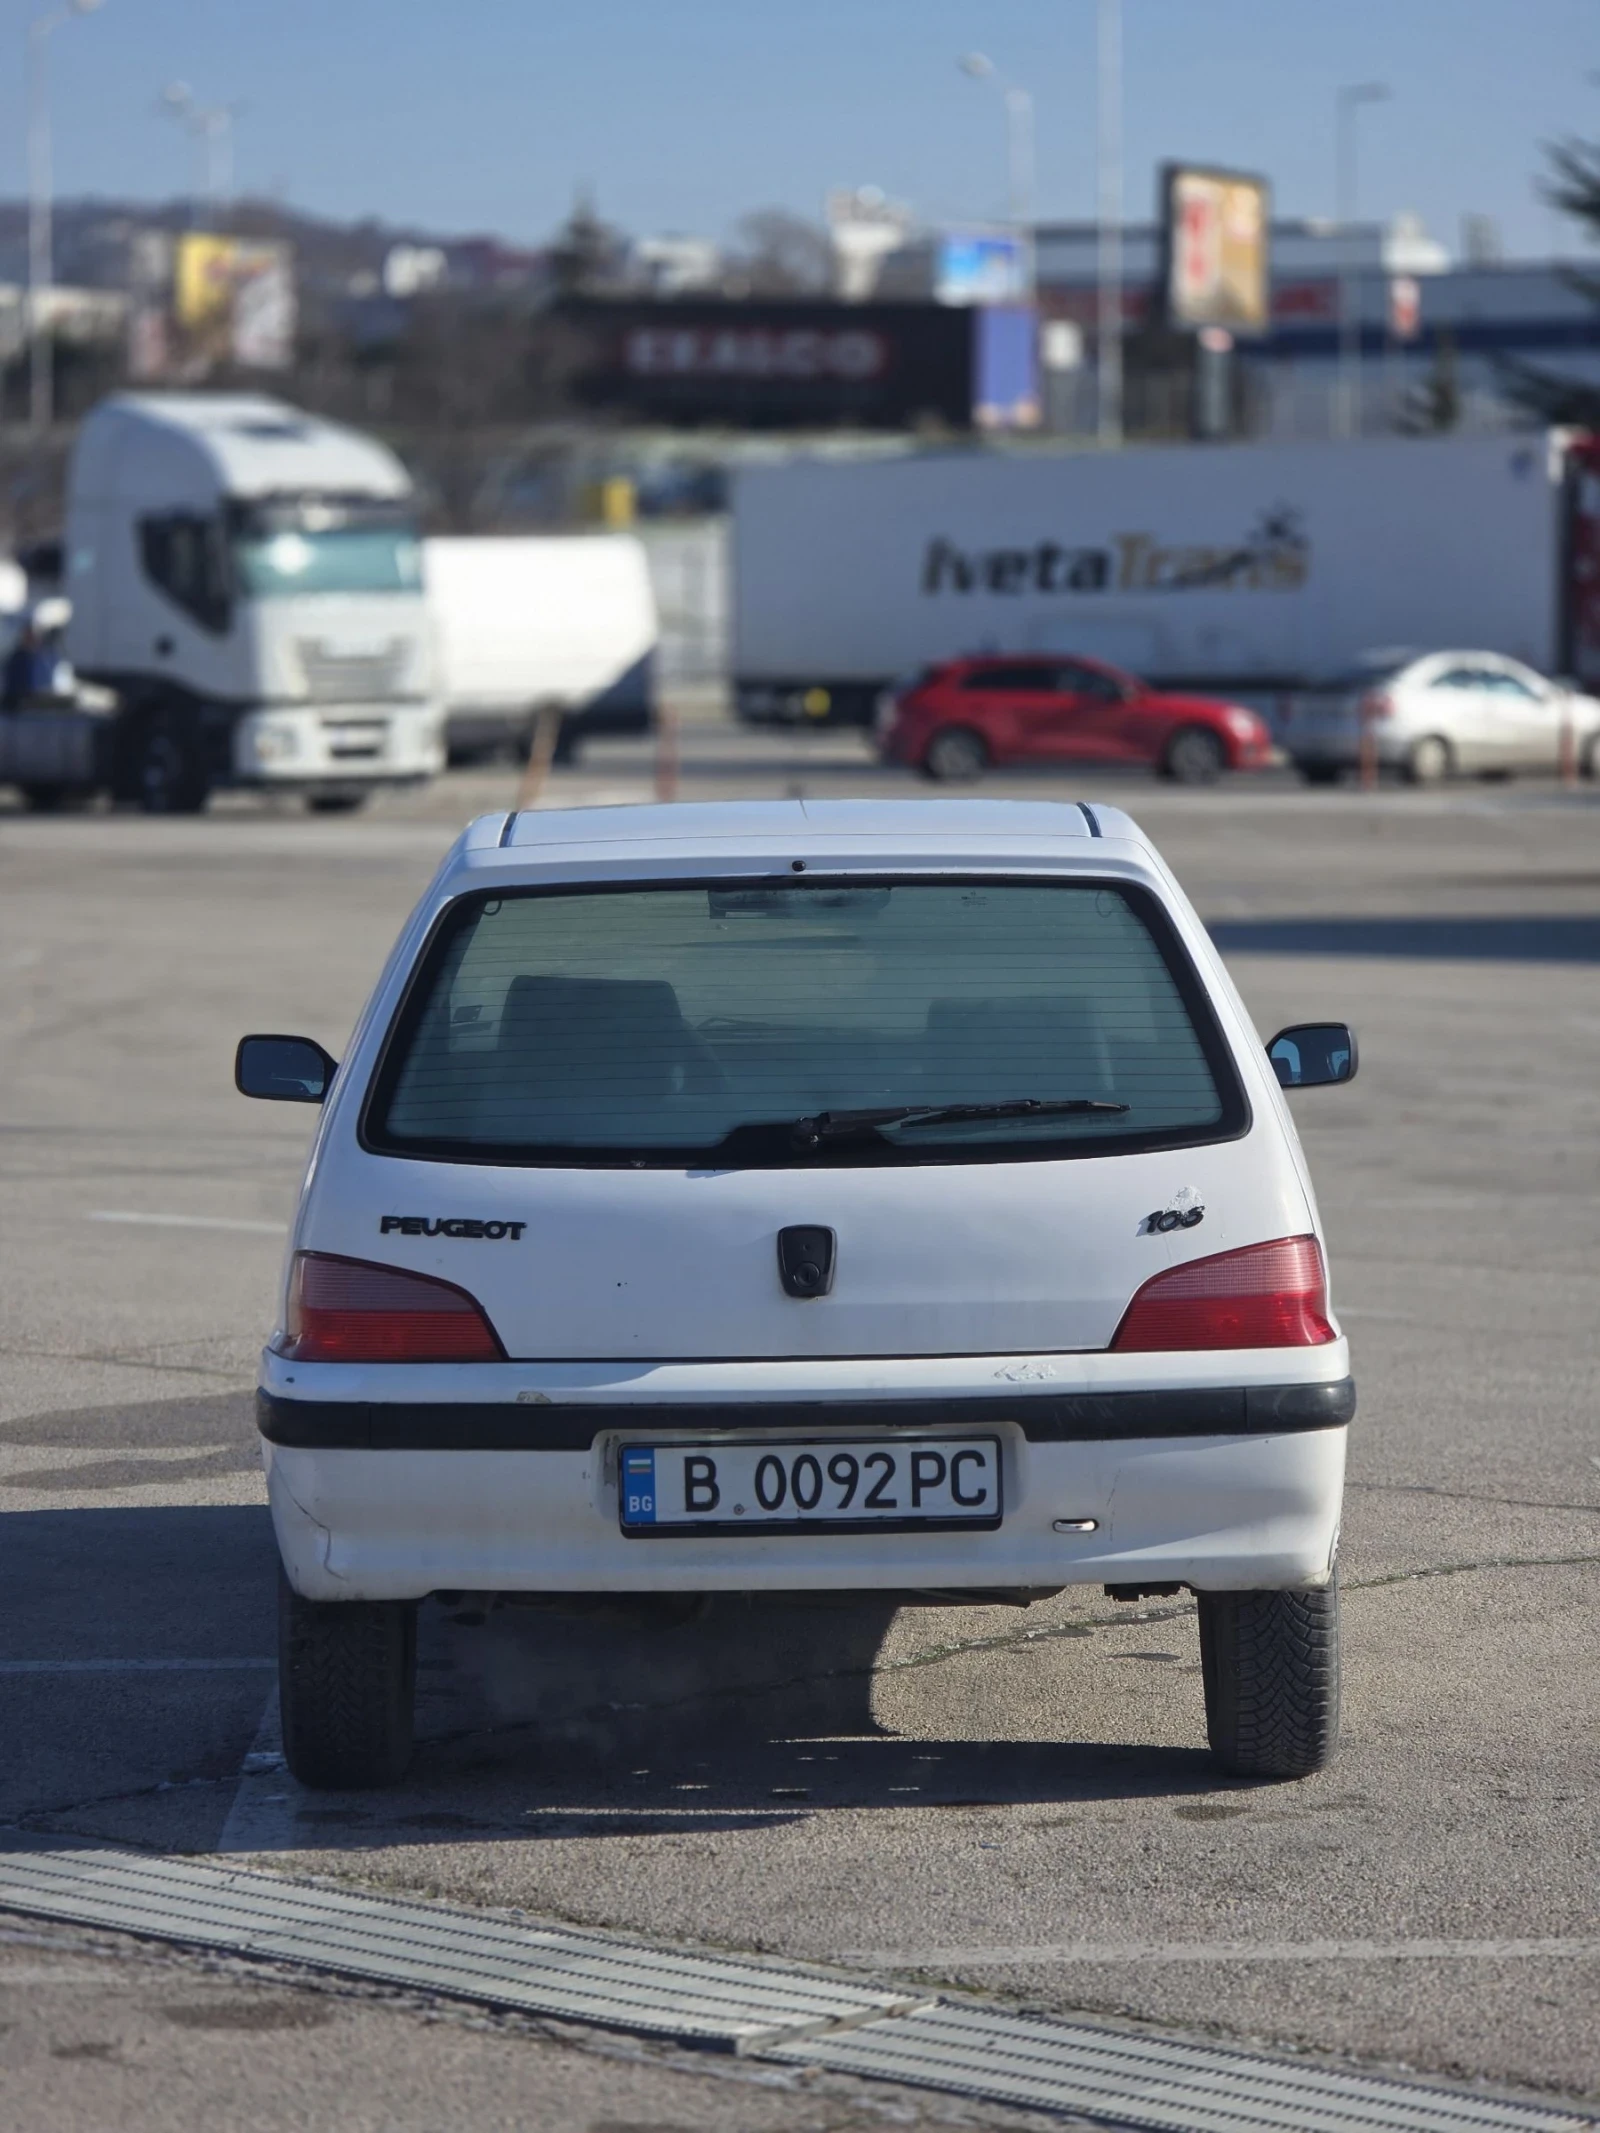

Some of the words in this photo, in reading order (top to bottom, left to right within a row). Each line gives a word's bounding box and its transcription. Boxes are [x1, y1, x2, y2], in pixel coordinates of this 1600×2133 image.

[380, 1215, 527, 1240] PEUGEOT
[1146, 1205, 1206, 1233] 106
[629, 1495, 653, 1512] BG
